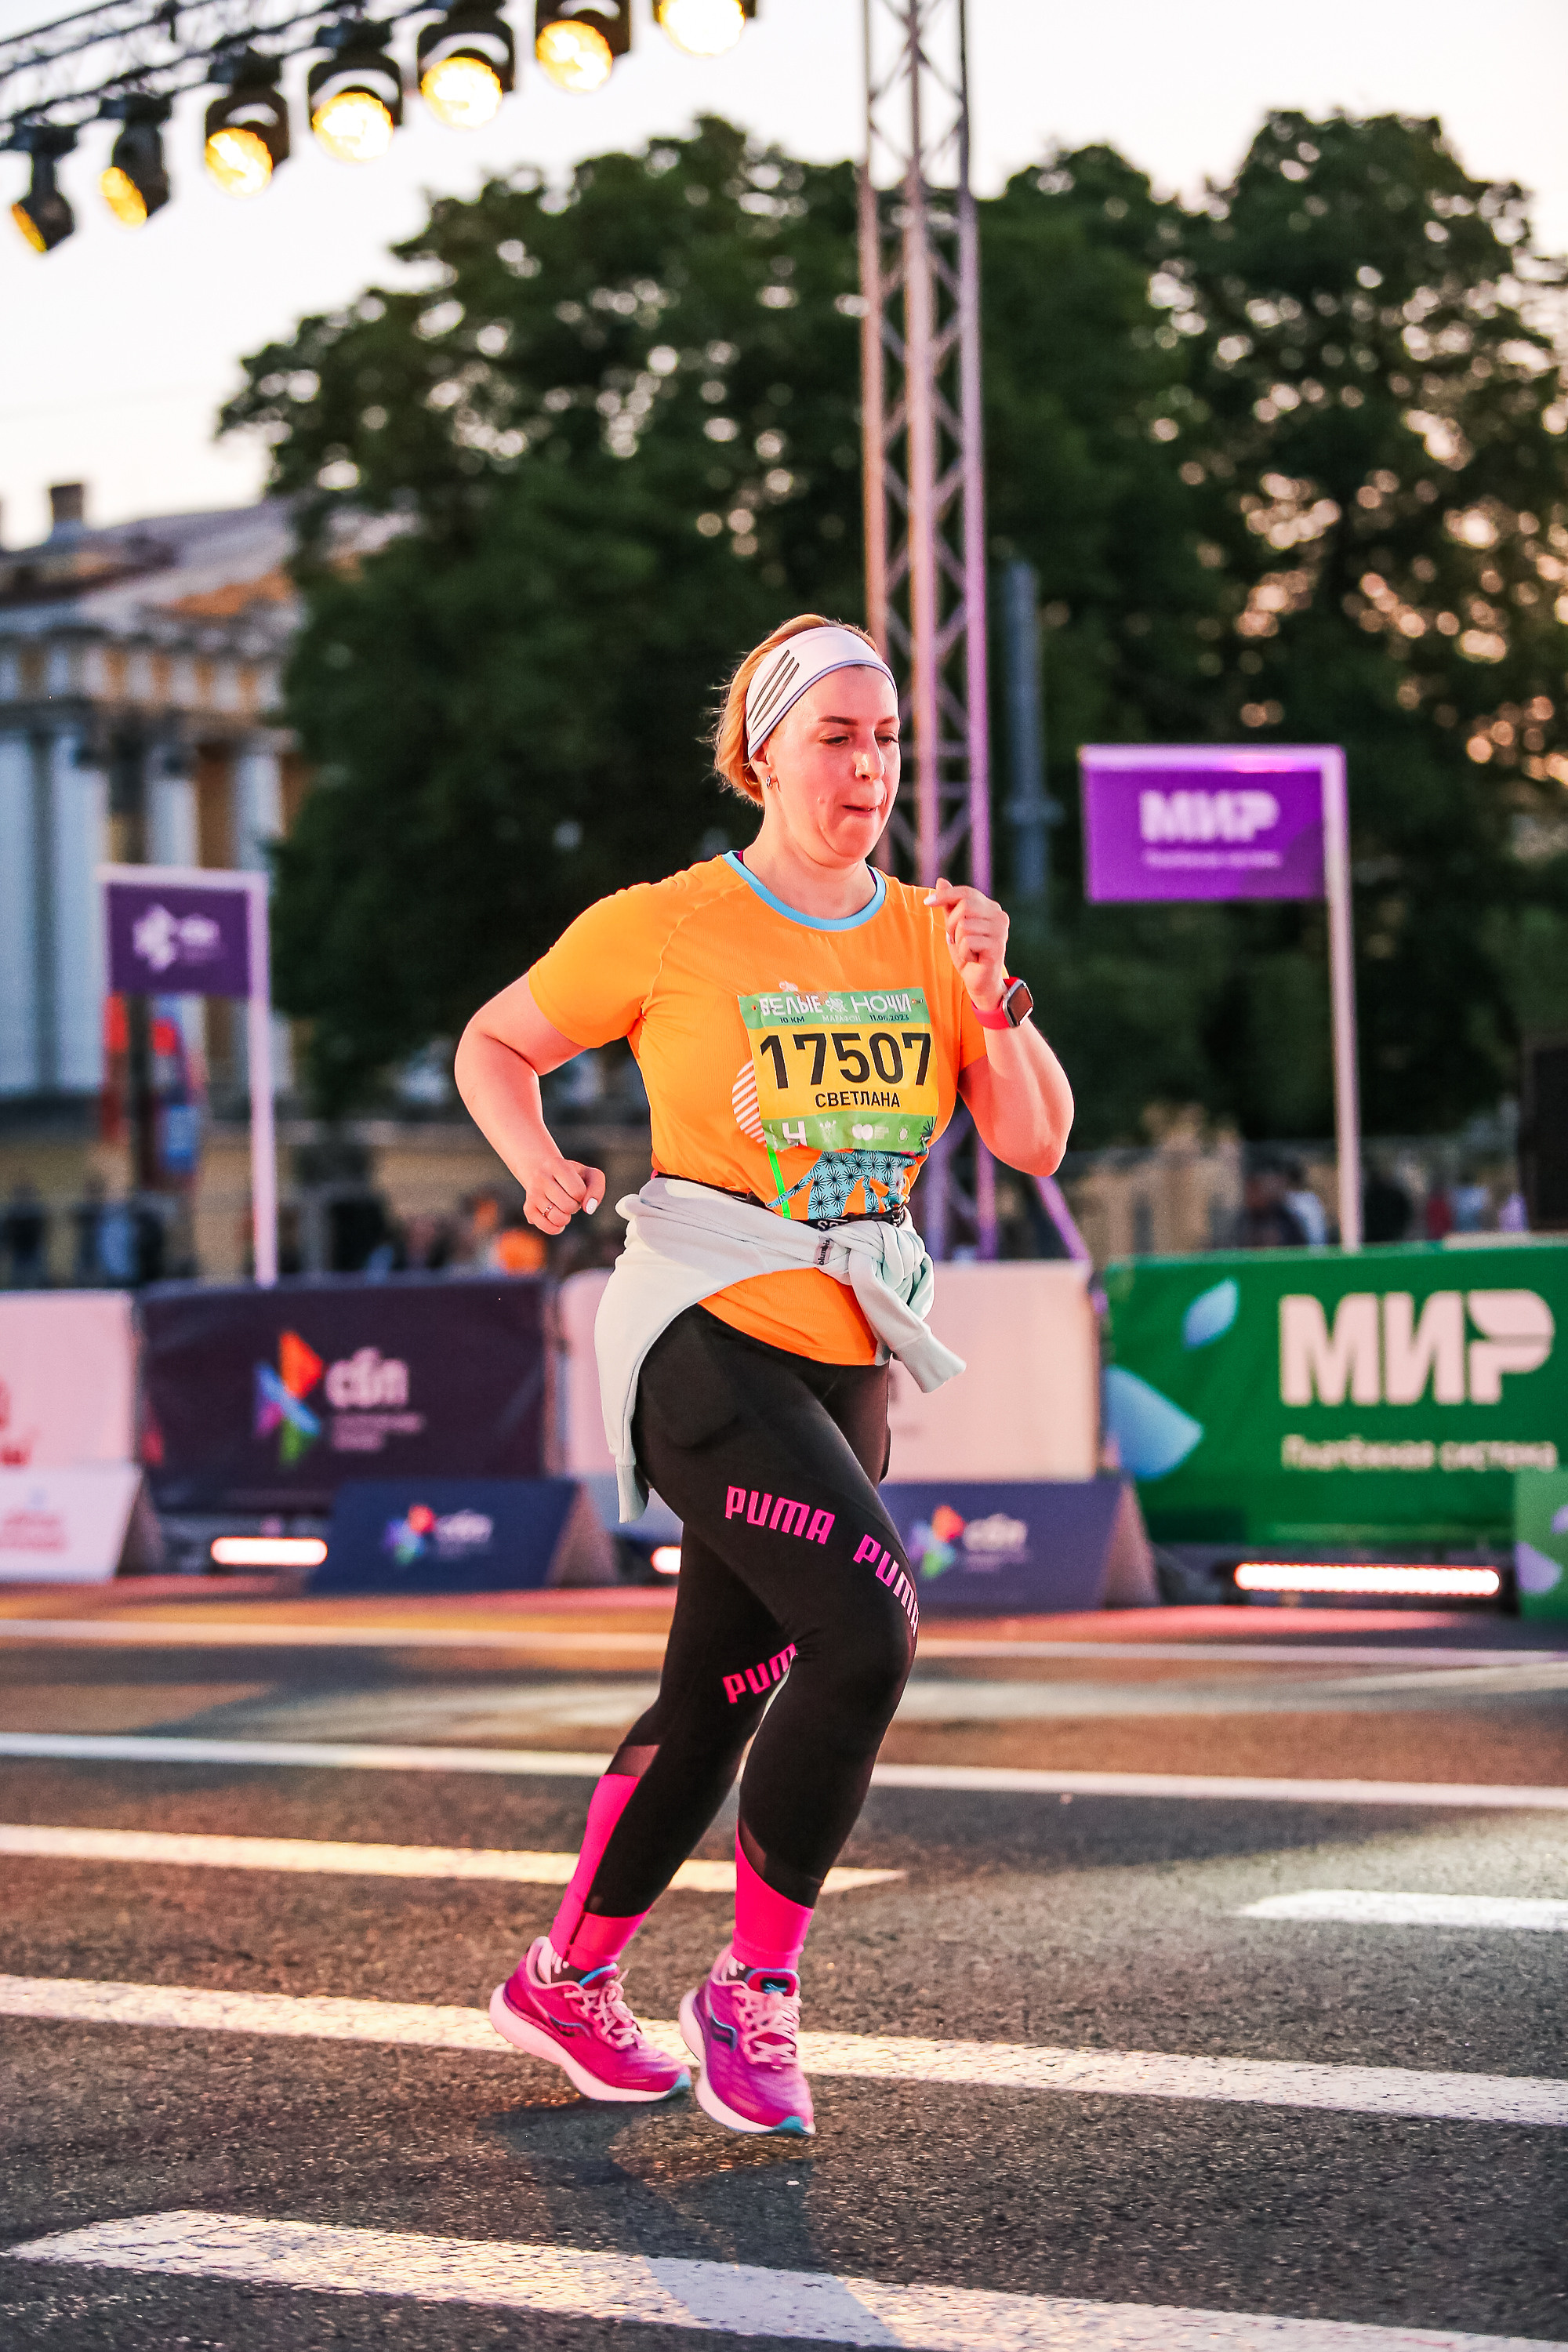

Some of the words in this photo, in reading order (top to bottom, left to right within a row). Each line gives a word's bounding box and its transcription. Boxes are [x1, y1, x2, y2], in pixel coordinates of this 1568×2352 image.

[851, 993, 912, 1013] НОЧИ
[759, 1032, 931, 1090] 17507
[815, 1091, 901, 1108] СВЕТЛАНА
[1279, 1289, 1555, 1406] МИР
[724, 1485, 836, 1544] PUMA
[852, 1534, 920, 1638] PUMA
[722, 1642, 797, 1704] PUM
